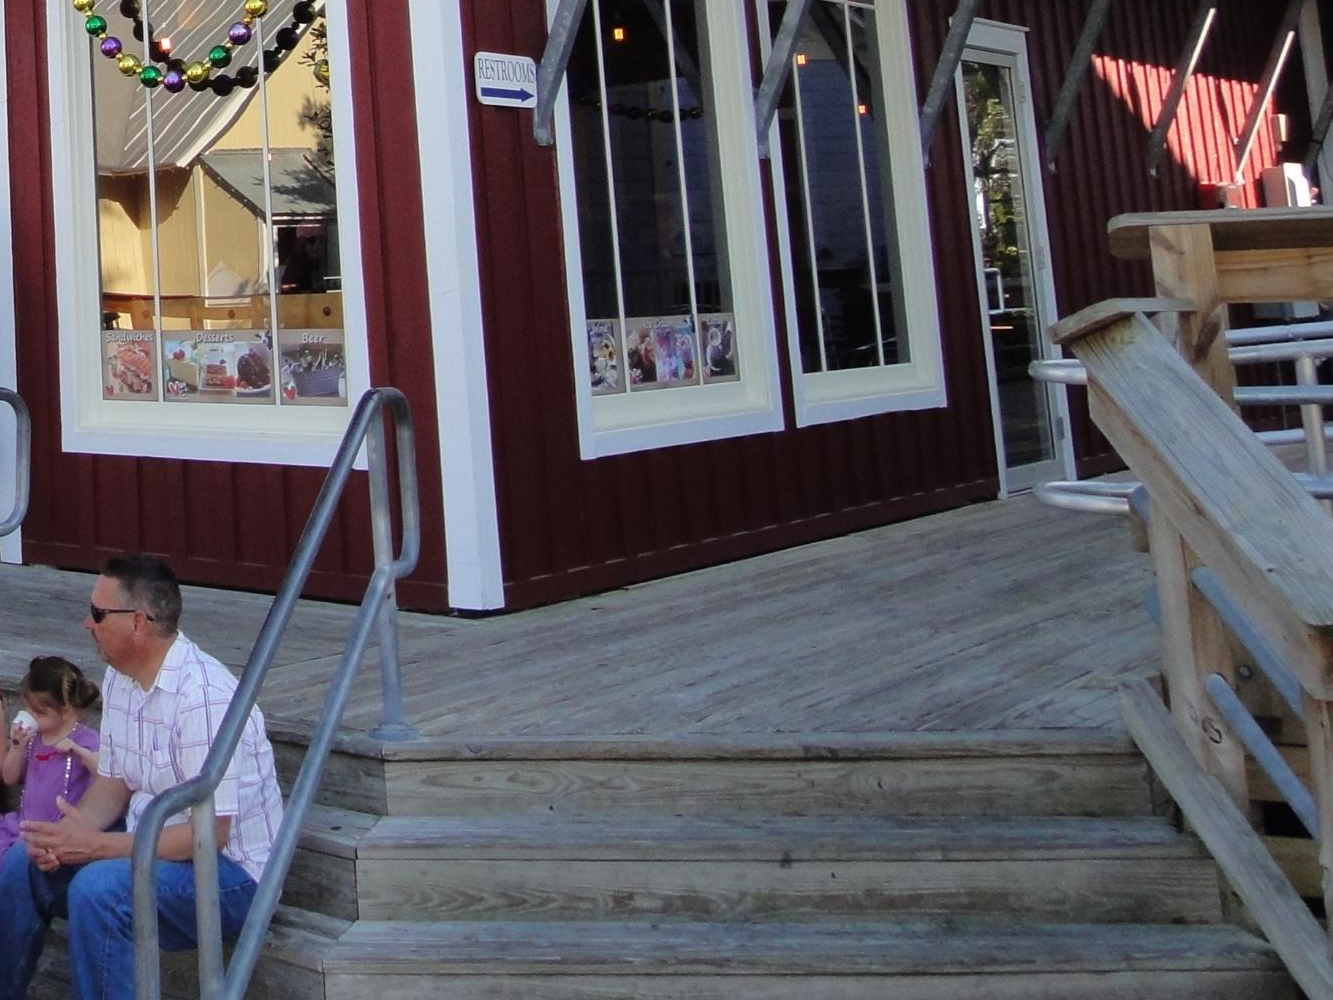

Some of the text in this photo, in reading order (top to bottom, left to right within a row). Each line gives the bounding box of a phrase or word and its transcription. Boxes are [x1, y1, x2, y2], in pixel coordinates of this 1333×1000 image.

[477, 58, 535, 83] RESTROOMS
[105, 332, 155, 344] Sandwiches
[196, 331, 235, 344] Desserts
[302, 333, 326, 344] Beer
